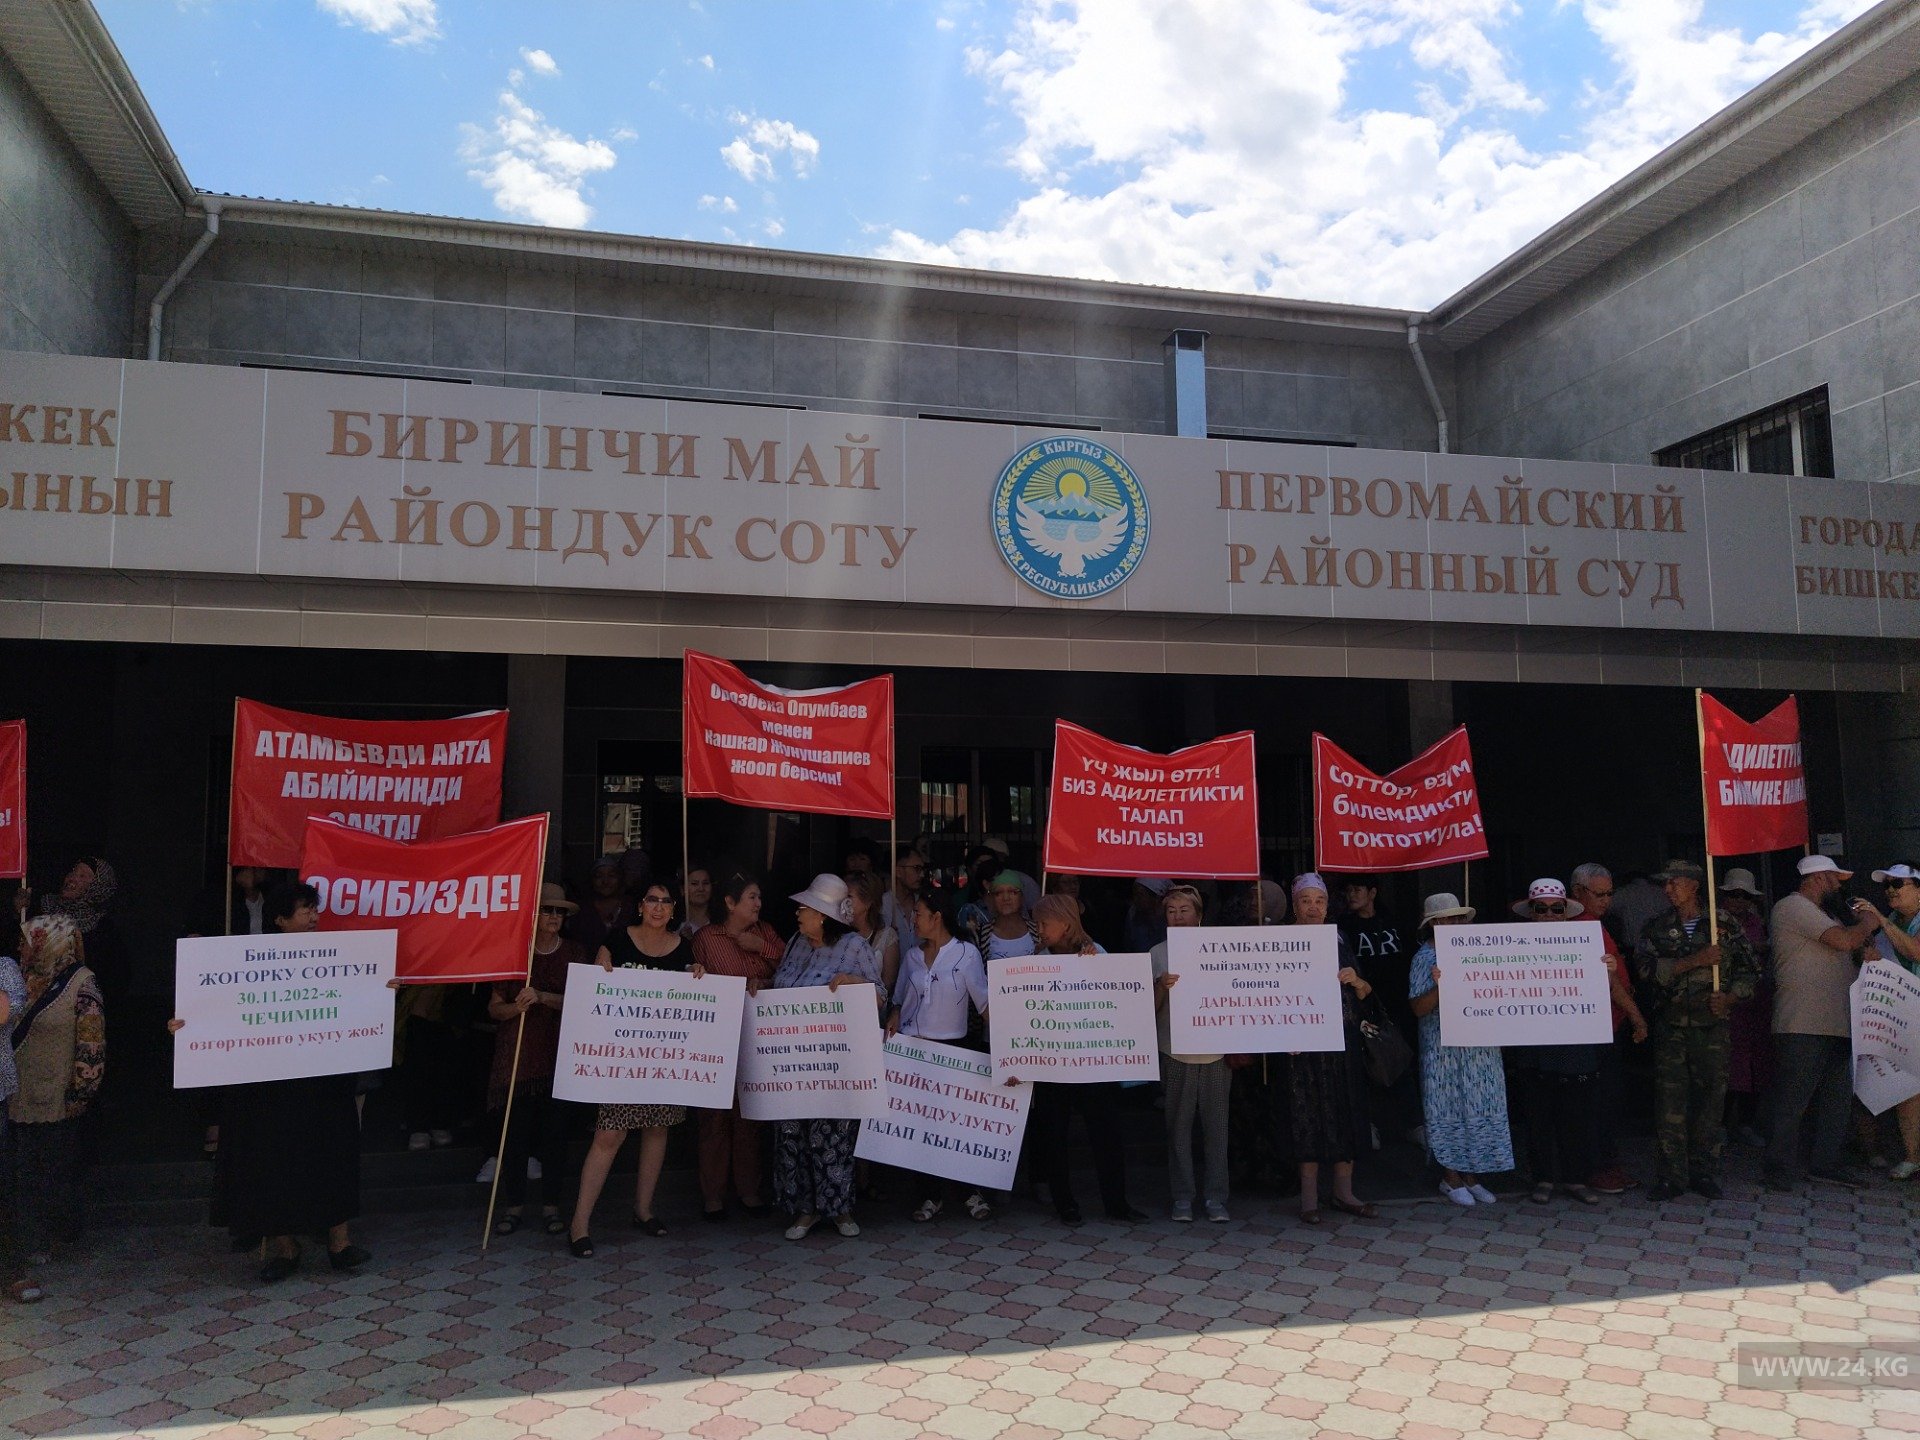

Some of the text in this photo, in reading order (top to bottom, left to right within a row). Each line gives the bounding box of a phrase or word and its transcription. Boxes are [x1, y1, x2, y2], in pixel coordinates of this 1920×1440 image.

[326, 409, 881, 490] БИРИНЧИ МАЙ
[1043, 440, 1103, 460] КЫРГЫЗ
[1215, 469, 1688, 533] ПЕРВОМАЙСКИЙ
[281, 485, 919, 570] РАЙОНДУК СОТУ
[1019, 563, 1125, 596] РЕСПУБЛИКАСЫ
[1225, 535, 1686, 610] РАЙОННЫЙ СУД
[787, 699, 868, 719] Опумбаев
[761, 720, 813, 740] менен
[431, 738, 493, 766] АКТА
[779, 763, 842, 786] берсин!
[1081, 756, 1221, 783] ҮЧ ЖЫЛ ӨТТҮ!
[1062, 776, 1244, 804] БИЗ АДИЛЕТТИКТИ
[1119, 806, 1184, 825] ТАЛАП
[1097, 827, 1204, 848] КЫЛАБЫЗ!
[1199, 940, 1312, 954] АТАМБАЕВДИН
[1451, 934, 1591, 947] 08.08.2019-ж. чыныгы
[245, 948, 338, 962] Бийликтин
[199, 962, 378, 987] ЖОГОРКУ СОТТУН
[1199, 960, 1312, 974] мыйзамдуу укугу
[1462, 968, 1584, 982] АРАШАН МЕНЕН
[595, 982, 717, 1003] Батукаев боюнча
[1048, 980, 1146, 993] Жээнбековдор,
[1231, 978, 1280, 990] боюнча
[1473, 986, 1583, 999] КОЙ-ТАШ ЭЛИ.
[236, 986, 342, 1006] 30.11.2022-ж.
[1199, 996, 1315, 1009] ДАРЫЛАНУУГА
[241, 1006, 339, 1026] ЧЕЧИМИН
[591, 1003, 716, 1023] АТАМБАЕВДИН
[756, 1001, 845, 1018] БАТУКАЕВДИ
[1462, 1003, 1597, 1018] Соке СОТТОЛСУН!
[756, 1022, 848, 1036] жалган диагноз
[1192, 1015, 1236, 1027] ШАРТ
[298, 1029, 344, 1047] укугу
[614, 1026, 690, 1043] соттолушу
[1010, 1036, 1136, 1052] К.Жунушалиевдер
[572, 1041, 724, 1064] МЫЙЗАМСЫЗ жана
[756, 1042, 852, 1056] менен чыгарып,
[772, 1061, 840, 1076] узаткандар
[930, 1053, 972, 1071] МЕНЕН
[999, 1054, 1151, 1069] ЖООПКО ТАРТЫЛСЫН!
[574, 1063, 718, 1083] ЖАЛГАН ЖАЛАА!
[795, 1077, 878, 1093] ТАРТЫЛСЫН!
[867, 1117, 1012, 1163] ТАЛАП КЫЛАБЫЗ!
